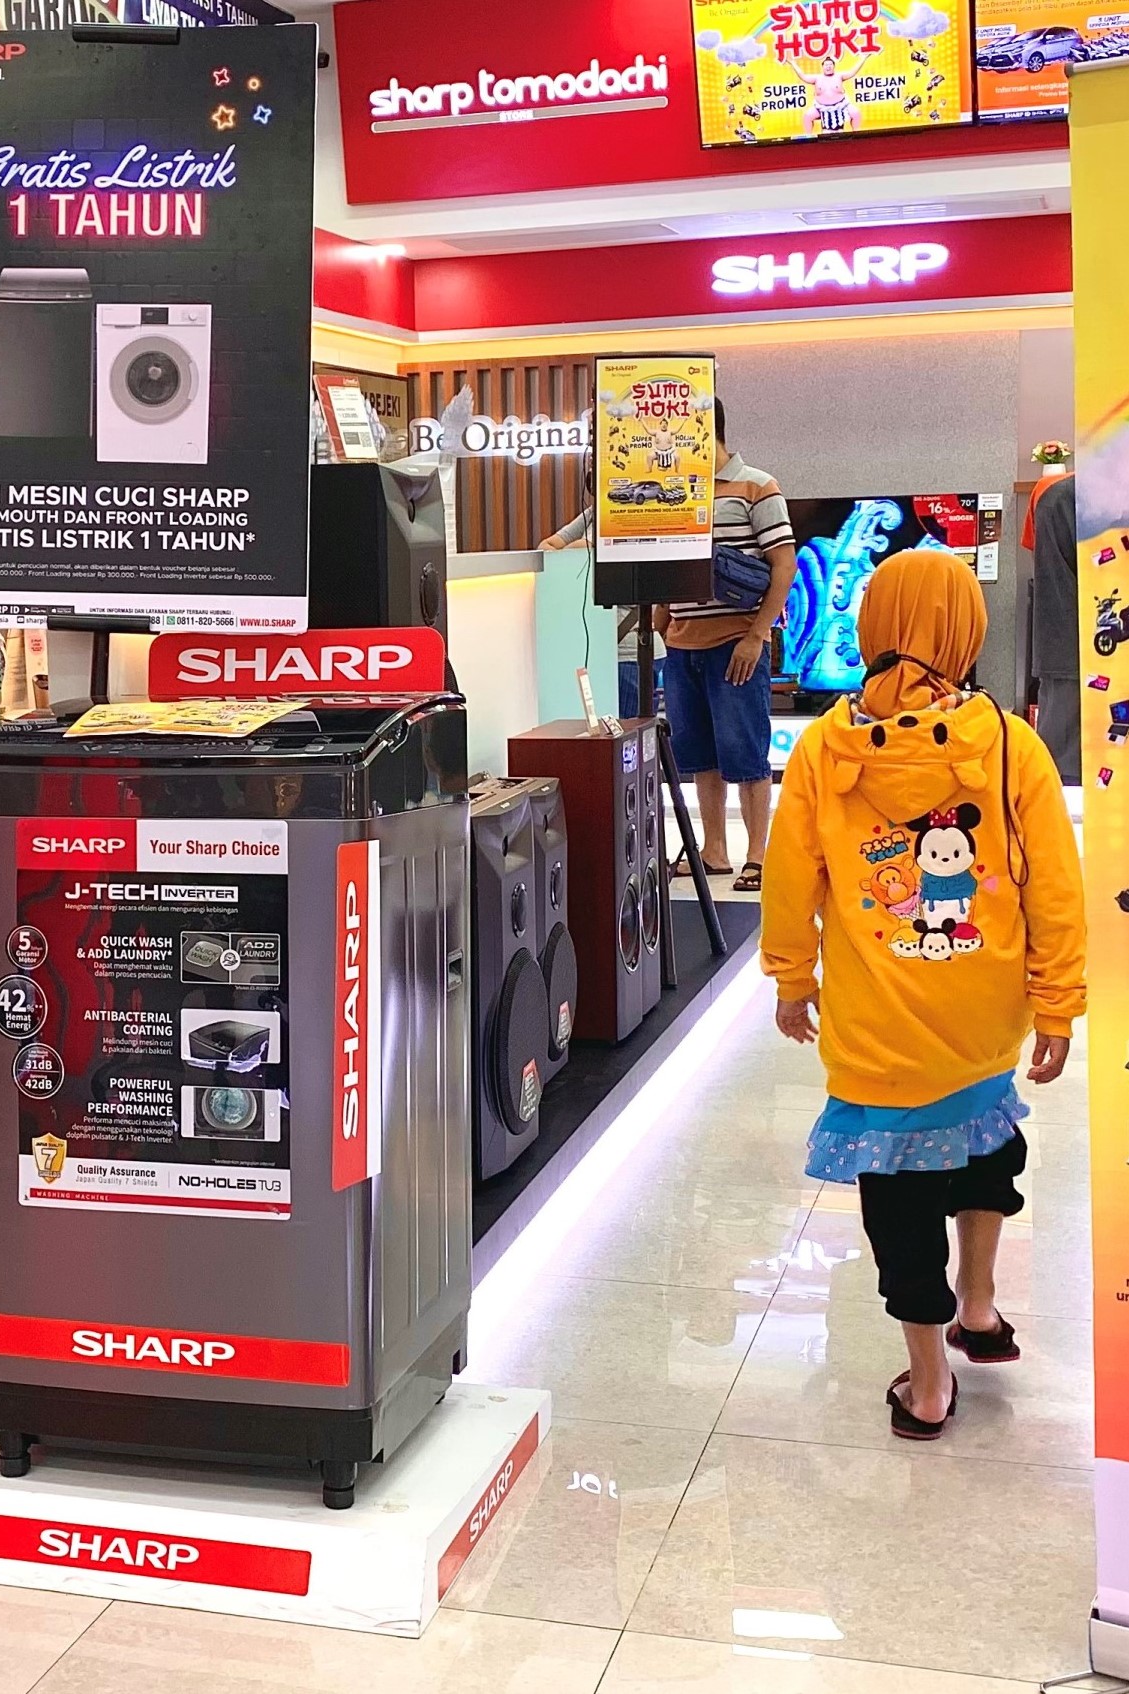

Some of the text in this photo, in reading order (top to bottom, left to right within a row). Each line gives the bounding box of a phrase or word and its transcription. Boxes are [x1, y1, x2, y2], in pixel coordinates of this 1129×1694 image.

[768, 0, 880, 31] SUMO
[774, 25, 881, 62] HOKI
[369, 54, 668, 116] sharp tomodachi
[854, 75, 906, 90] HOEJAN
[763, 84, 806, 98] SUPER
[855, 87, 901, 103] REJEKI
[761, 96, 807, 111] PROMO
[95, 143, 236, 189] Listrik
[9, 193, 204, 237] 1 TAHUN
[710, 242, 950, 294] SHARP
[631, 382, 691, 400] SUMO
[634, 400, 691, 419] HOKI
[461, 421, 591, 460] Origina
[8, 485, 87, 507] MESIN
[95, 486, 155, 508] CUCI
[162, 488, 250, 509] SHARP
[63, 511, 101, 524] DAN
[106, 512, 165, 526] FRONT
[170, 512, 248, 527] LOADING
[41, 529, 133, 550] LISTRIK
[140, 531, 150, 550] 1
[9, 605, 21, 614] ID
[176, 616, 296, 628] 0811-820-5666 WWW.ID.SHARP
[176, 645, 413, 683] SHARP
[32, 837, 280, 858] SHARP Your Sharp Choice
[64, 882, 235, 901] J-TECH INVERTER
[64, 903, 99, 913] Menghemat
[99, 904, 118, 913] energi
[170, 906, 205, 915] mengurangi
[206, 906, 239, 915] kebisingan
[18, 931, 31, 951] 5
[100, 935, 173, 949] QUICK WASH
[243, 940, 275, 949] ADD
[15, 950, 40, 958] Garansi
[18, 956, 38, 964] Motor
[76, 948, 86, 959] &
[87, 948, 111, 960] ADD
[239, 949, 277, 959] LAUNDRY
[93, 962, 173, 972] Dapat menghemat waktu
[94, 969, 173, 980] dalam proses pencucian.
[5, 1012, 32, 1022] Hemat
[83, 1010, 173, 1023] ANTIBACTERIAL
[343, 880, 362, 1141] SHARP
[6, 1020, 31, 1032] Energi
[122, 1024, 173, 1036] COATING
[102, 1037, 139, 1047] Melindungi
[108, 1046, 134, 1054] pakaian
[134, 1046, 148, 1054] dari
[25, 1059, 53, 1070] 31dB
[24, 1079, 53, 1090] 42dB
[109, 1077, 173, 1091] POWERFUL
[118, 1091, 173, 1104] WASHING
[87, 1102, 173, 1117] PERFORMANCE
[83, 1115, 113, 1124] Performa
[113, 1117, 141, 1125] mencuci
[66, 1131, 91, 1140] dolphin
[91, 1132, 118, 1141] pulsator
[125, 1134, 146, 1142] J-Tech
[72, 1124, 173, 1136] dengan menggunakan teknologi
[40, 1149, 58, 1171] 7
[77, 1165, 156, 1178] Quality Assurance
[75, 1175, 96, 1185] Japan
[98, 1176, 123, 1187] Quality
[132, 1178, 158, 1187] Shields
[178, 1175, 256, 1190] NO-HOLES
[36, 1190, 110, 1202] WASHING MACHINE
[71, 1328, 235, 1369] SHARP
[468, 1460, 514, 1545] SHARP
[37, 1527, 200, 1573] SHARP
